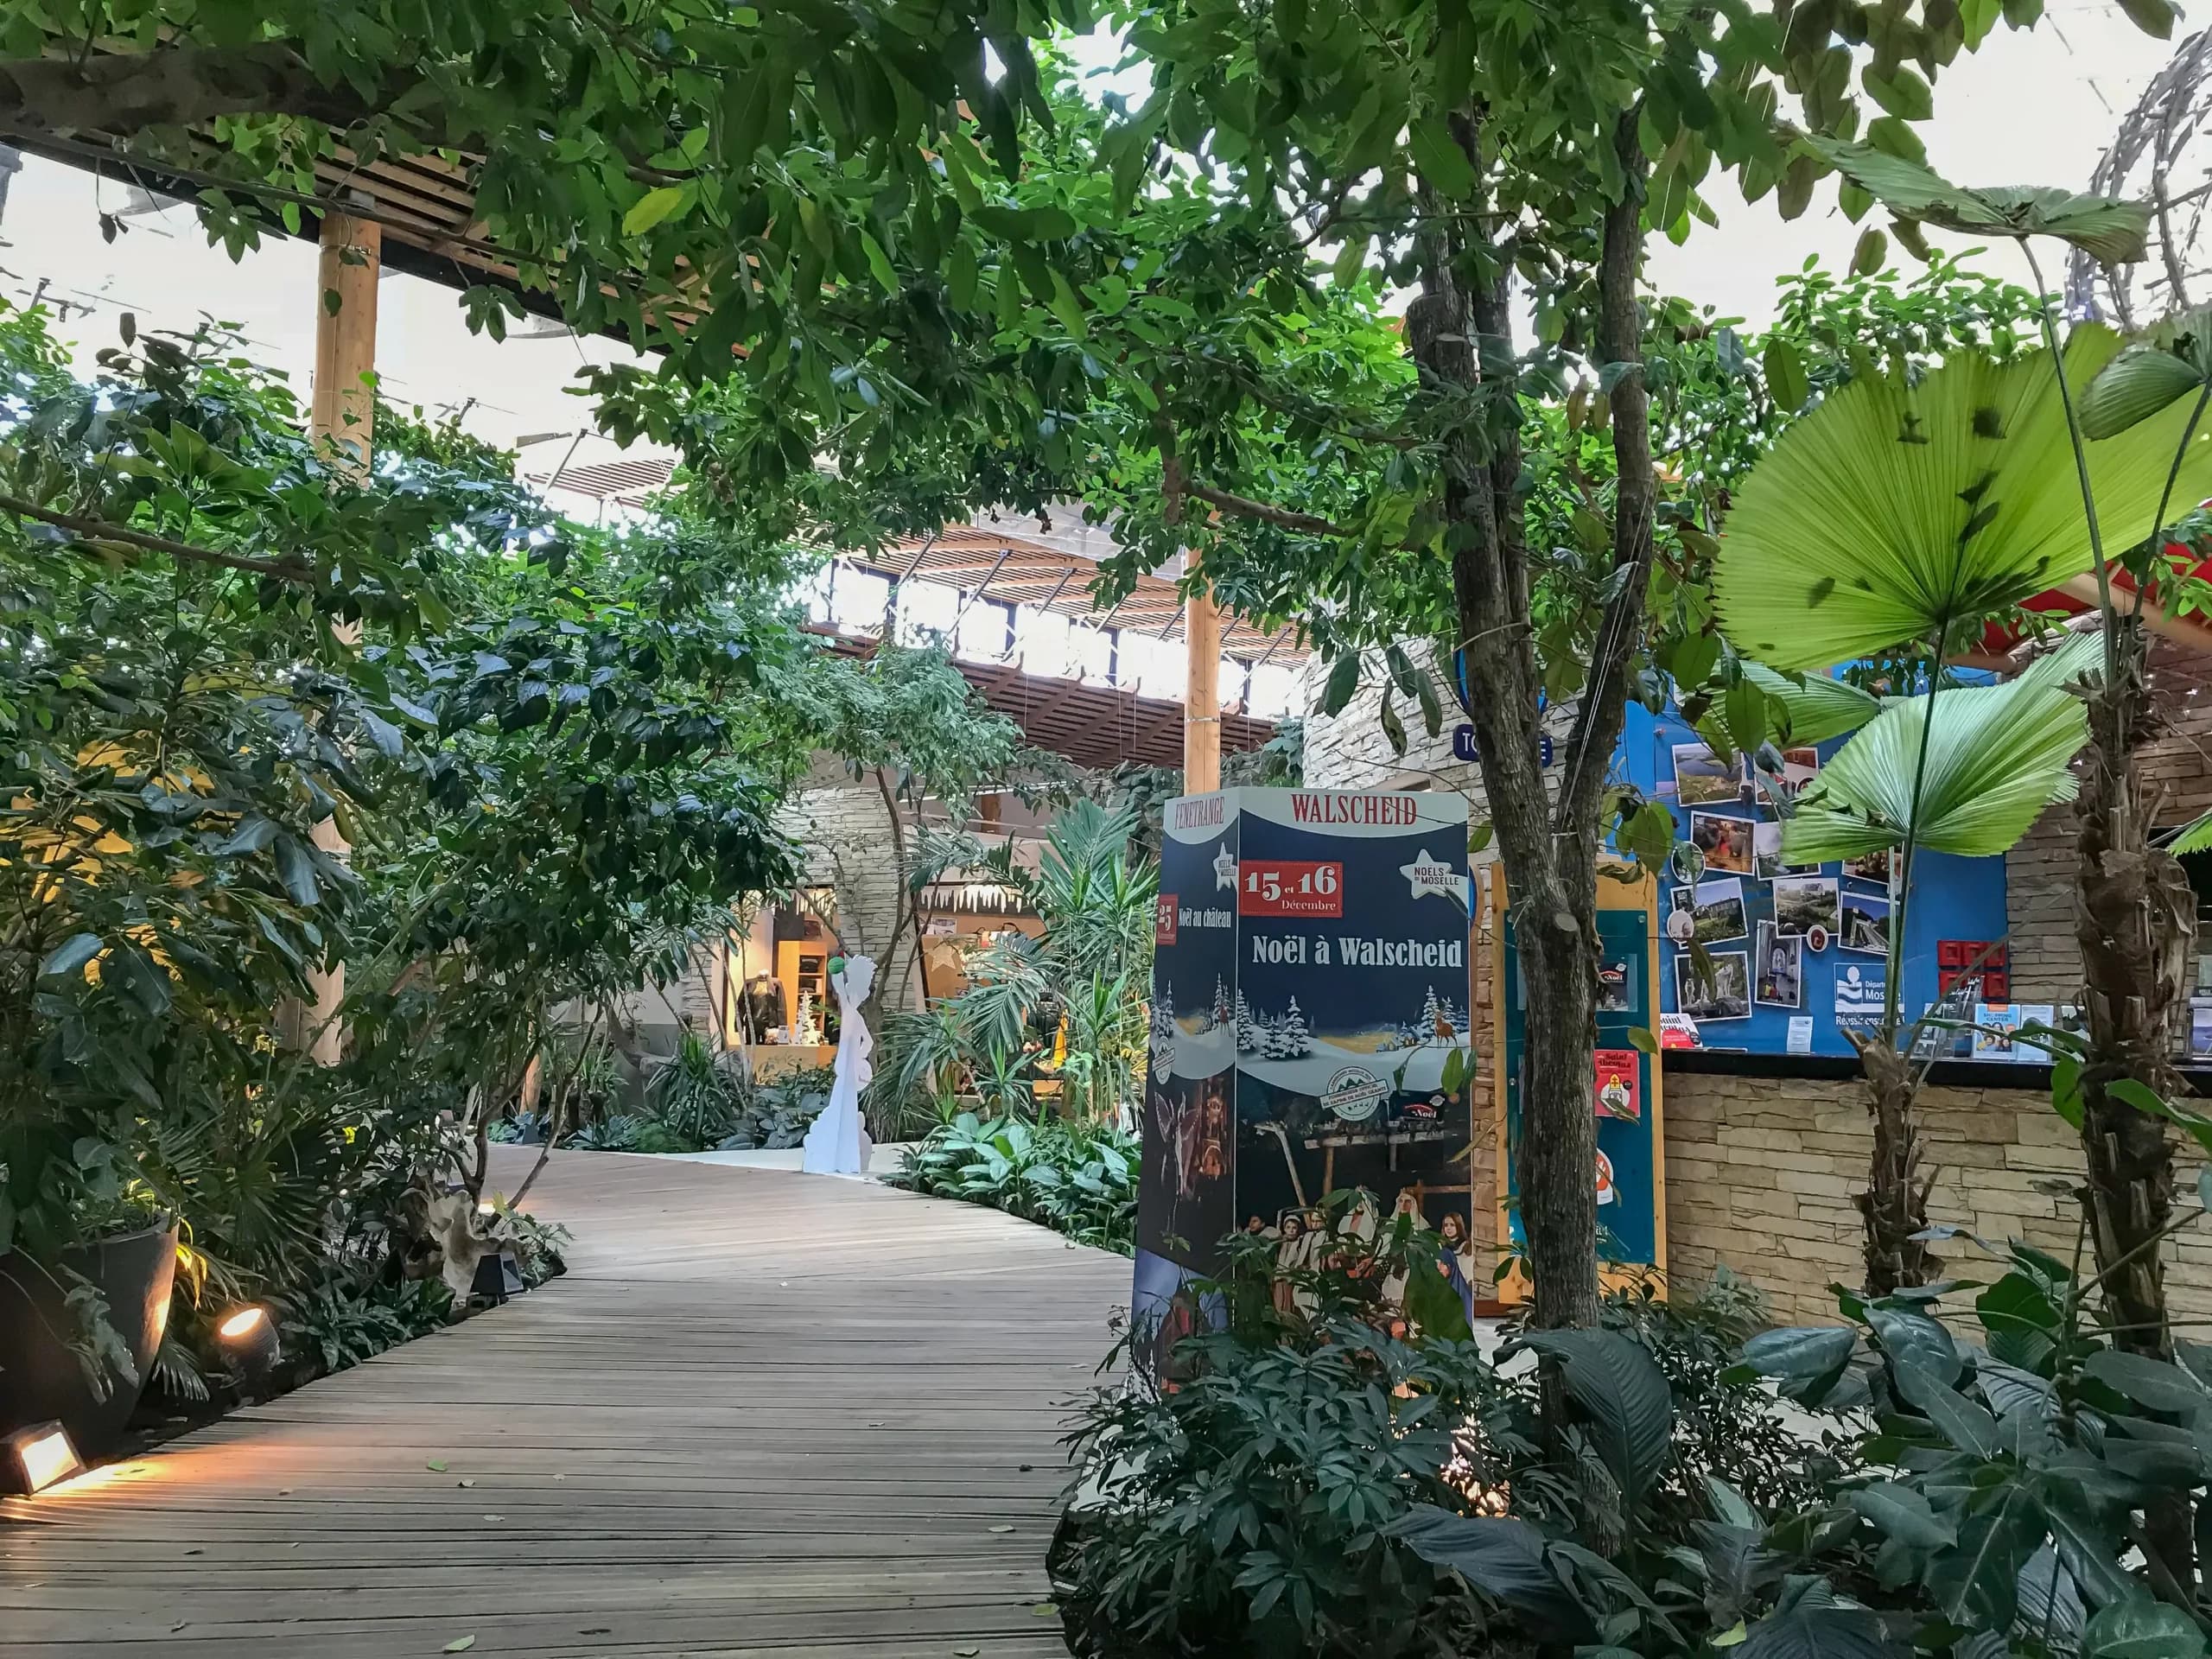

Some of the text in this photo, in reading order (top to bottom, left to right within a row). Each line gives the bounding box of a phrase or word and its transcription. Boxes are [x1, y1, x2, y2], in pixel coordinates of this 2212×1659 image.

[1291, 793, 1417, 825] WALSCHEID
[1244, 871, 1281, 901] 15
[1297, 866, 1337, 895] 16
[1421, 876, 1459, 886] MOSELLE
[1281, 899, 1337, 911] Décembre
[1192, 911, 1203, 927] au
[1253, 935, 1463, 968] Noël à Walscheid
